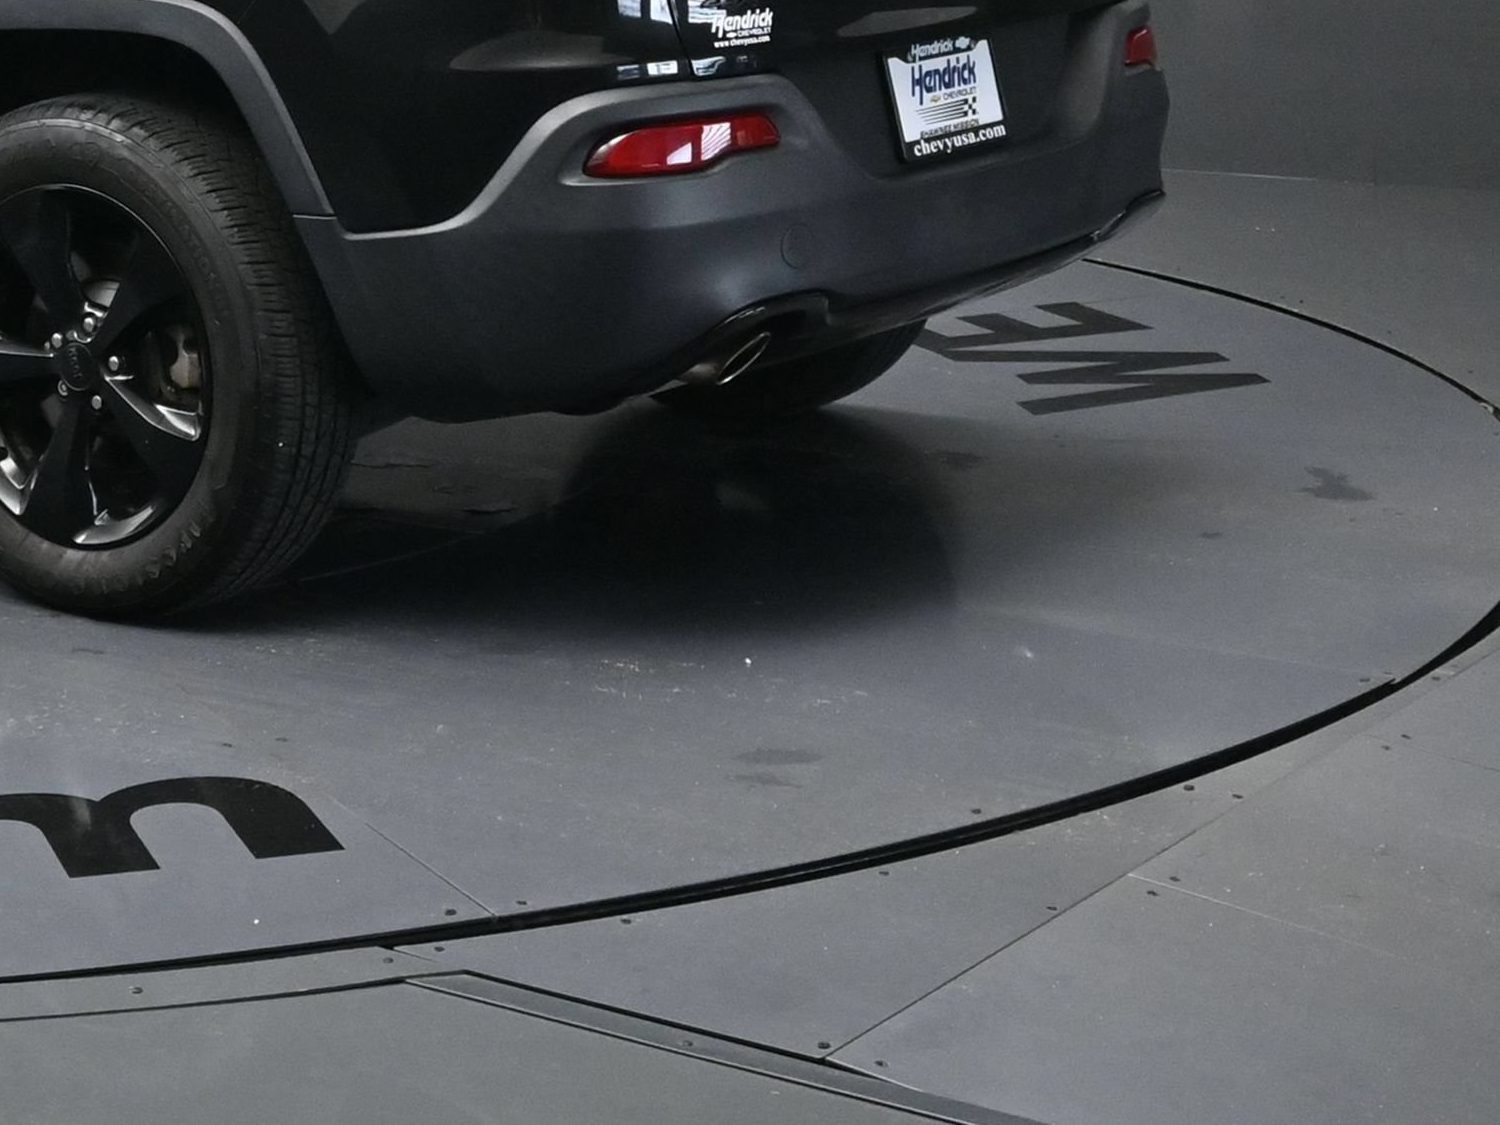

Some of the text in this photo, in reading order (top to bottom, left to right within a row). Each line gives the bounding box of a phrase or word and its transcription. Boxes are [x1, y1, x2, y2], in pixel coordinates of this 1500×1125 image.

[711, 7, 773, 38] Hendrick
[911, 38, 954, 63] Hendrick
[911, 54, 977, 106] Hendrick
[943, 86, 977, 101] CHEVROLET
[913, 124, 1006, 156] chevyusa.com
